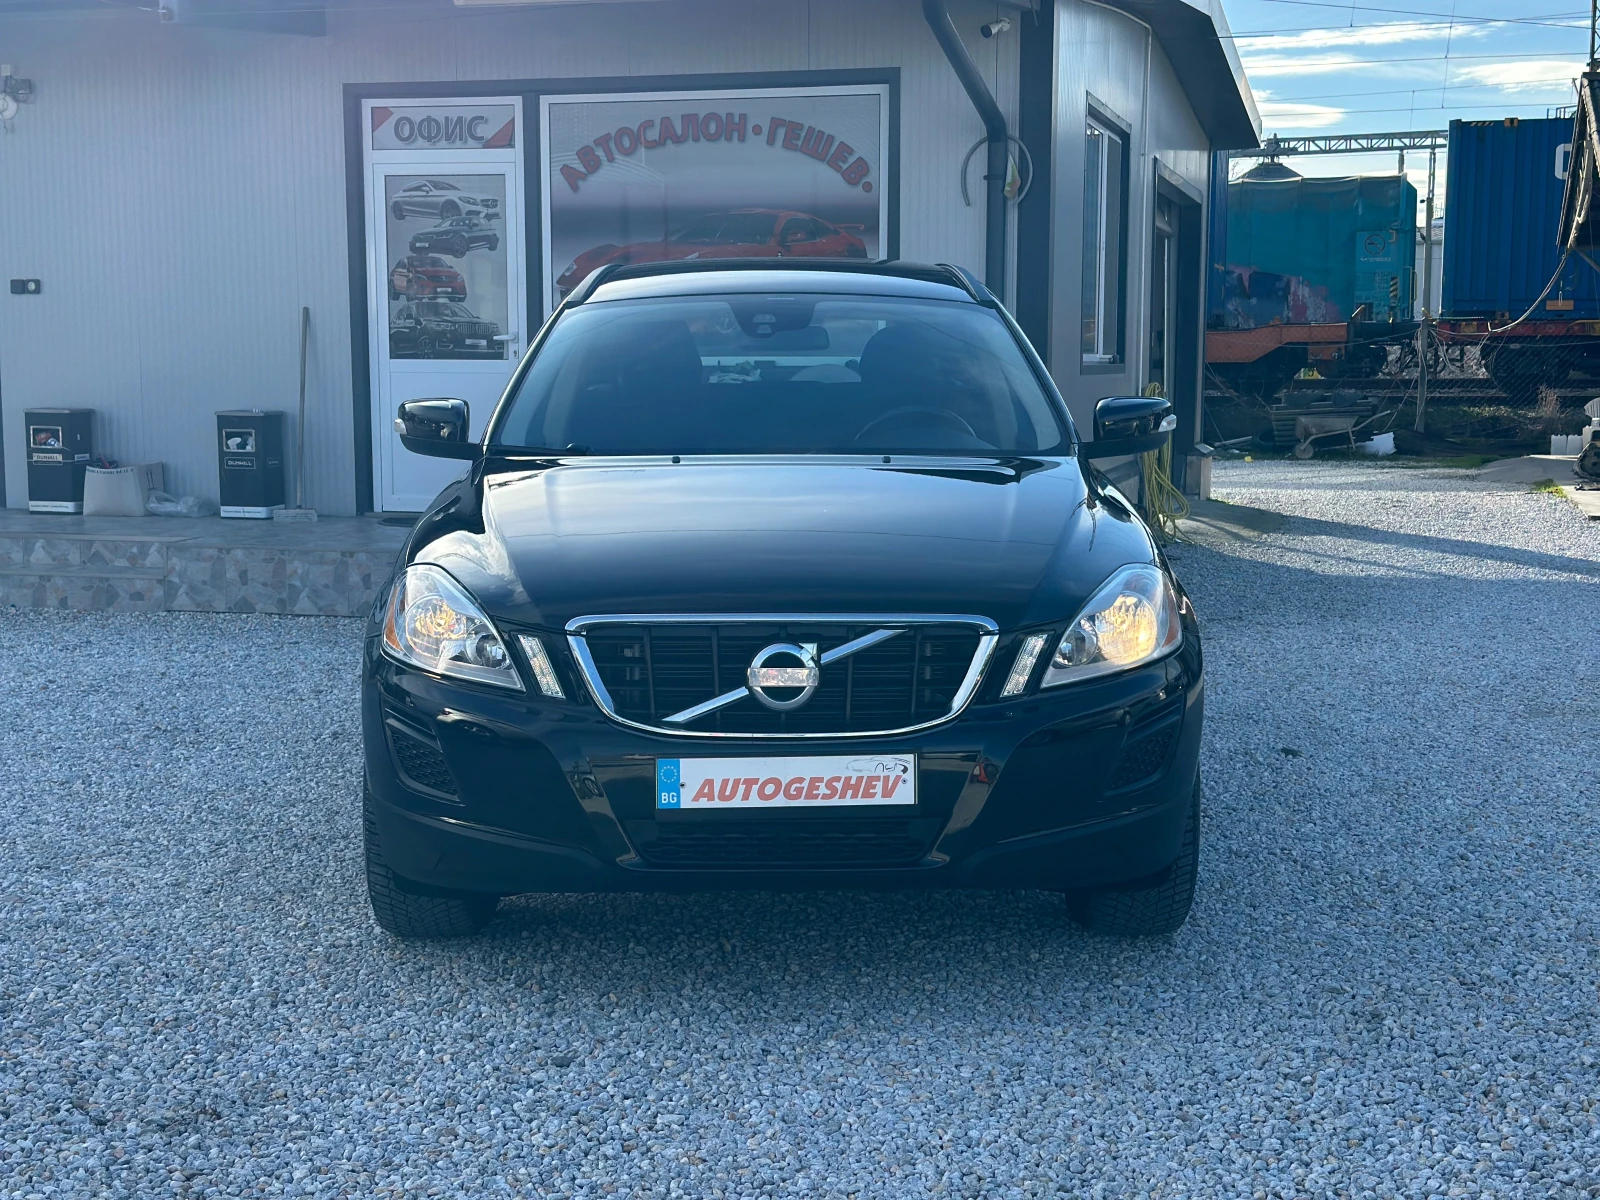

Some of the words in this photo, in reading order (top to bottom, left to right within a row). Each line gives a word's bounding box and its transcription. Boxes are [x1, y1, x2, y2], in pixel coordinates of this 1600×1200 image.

[393, 115, 486, 143] ОФИС
[559, 111, 747, 193] АВТОСАЛОН
[661, 791, 678, 804] BG
[691, 774, 903, 803] AUTOGESHEV
